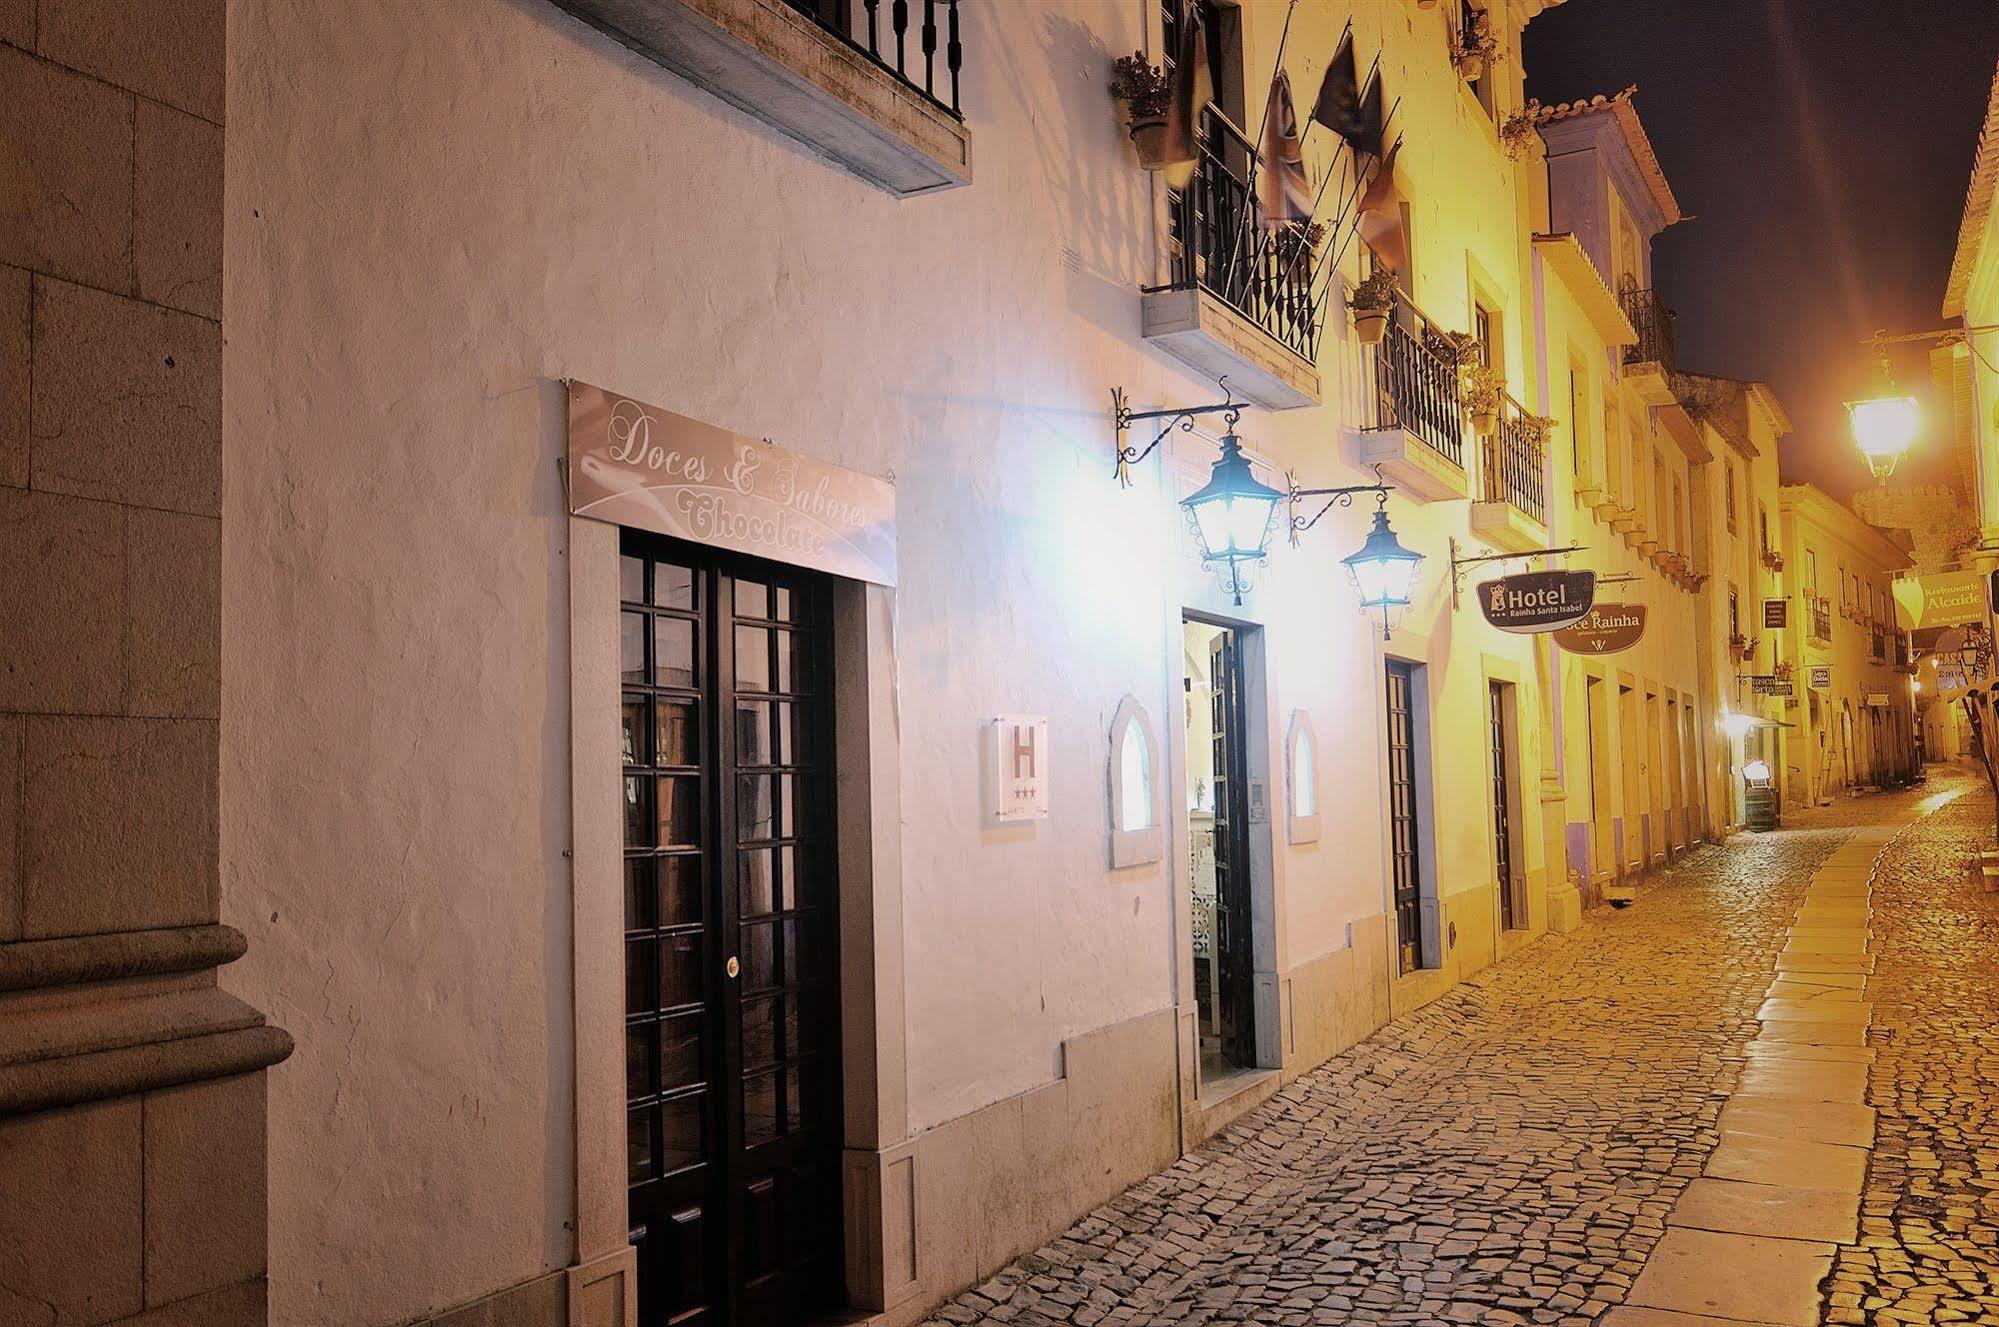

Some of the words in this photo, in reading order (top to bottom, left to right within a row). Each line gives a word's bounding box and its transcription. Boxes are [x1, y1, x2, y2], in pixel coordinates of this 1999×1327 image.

[608, 400, 712, 482] Doces
[724, 446, 760, 495] &
[772, 458, 865, 527] Sabores
[1509, 583, 1566, 609] Hotel
[1927, 592, 1982, 608] Alcaide
[1510, 607, 1535, 618] Rainha
[1537, 604, 1558, 615] Santa
[1559, 603, 1583, 613] Isabel
[1592, 614, 1640, 629] Rainha
[1014, 725, 1035, 779] H
